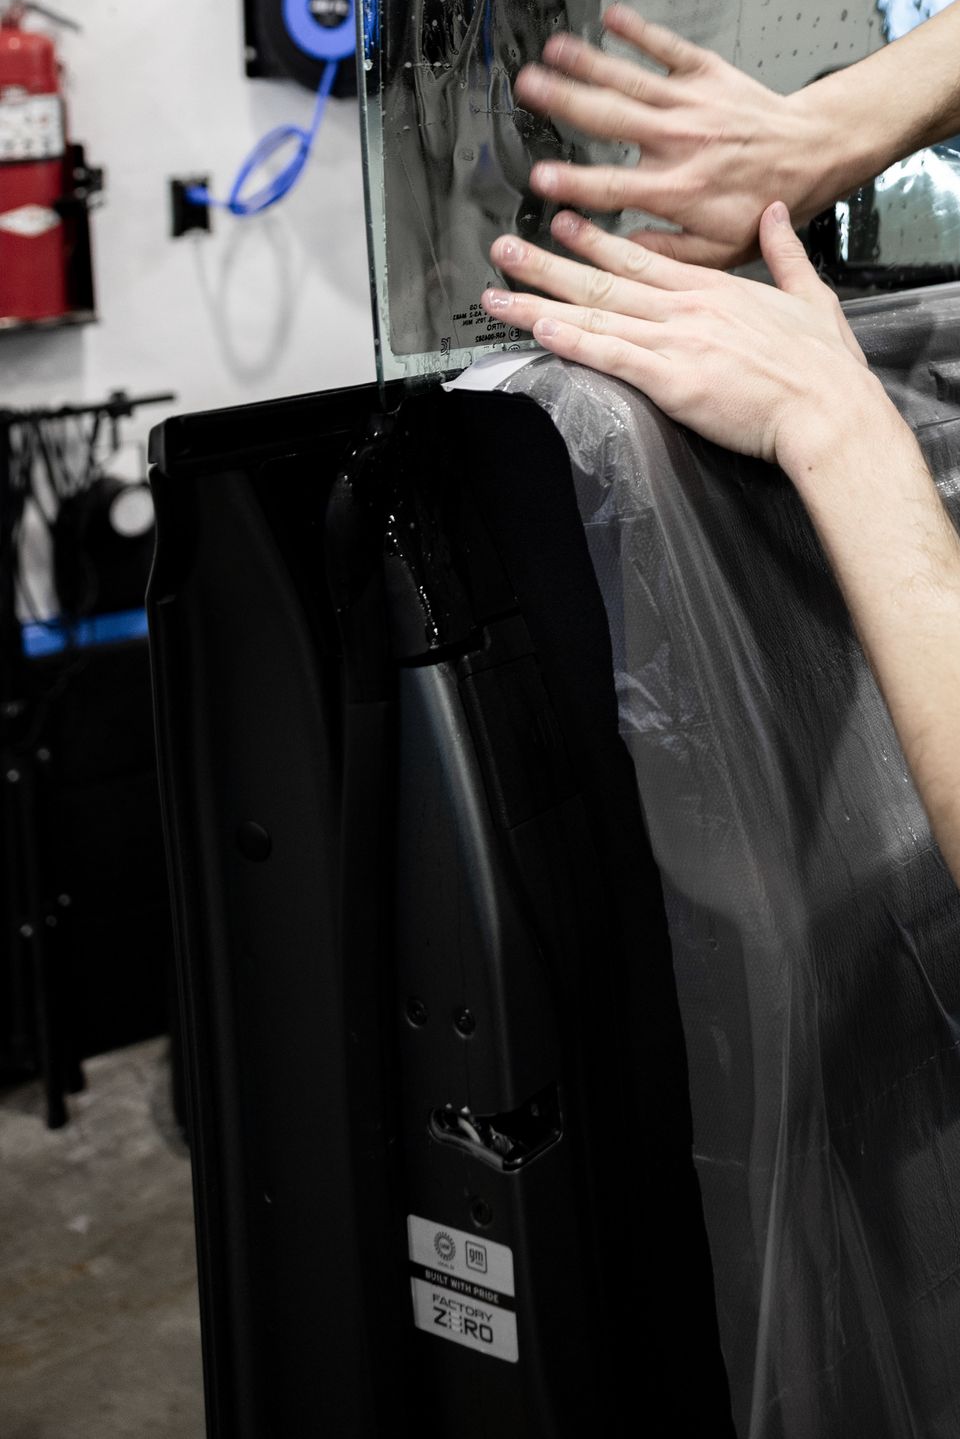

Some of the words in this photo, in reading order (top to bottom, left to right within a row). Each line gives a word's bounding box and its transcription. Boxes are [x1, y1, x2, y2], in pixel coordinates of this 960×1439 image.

[469, 1248, 484, 1263] gm
[425, 1269, 448, 1285] BUILT
[450, 1278, 472, 1293] WITH
[473, 1286, 500, 1304] PRIDE
[432, 1293, 494, 1322] FACTORY
[433, 1306, 494, 1344] ZERO
